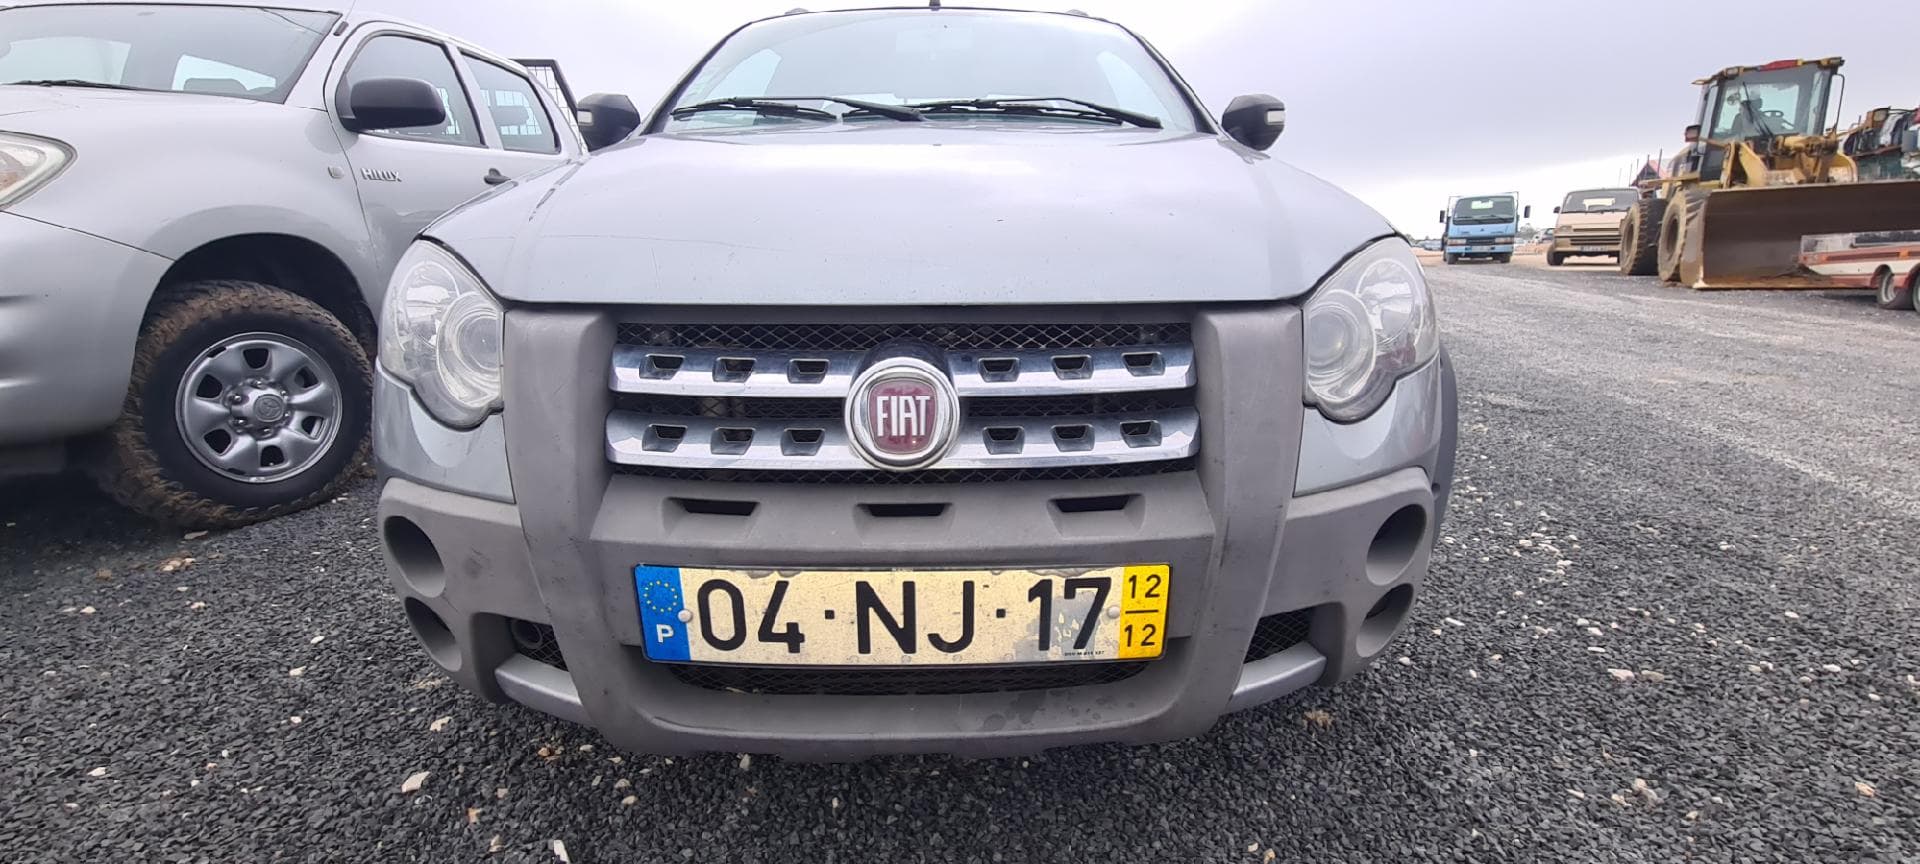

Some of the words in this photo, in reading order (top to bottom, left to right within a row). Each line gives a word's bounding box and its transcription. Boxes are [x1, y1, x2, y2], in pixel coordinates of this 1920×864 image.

[876, 395, 931, 437] FIAT
[1127, 574, 1162, 599] 12
[656, 624, 674, 643] P
[1124, 624, 1157, 648] 12
